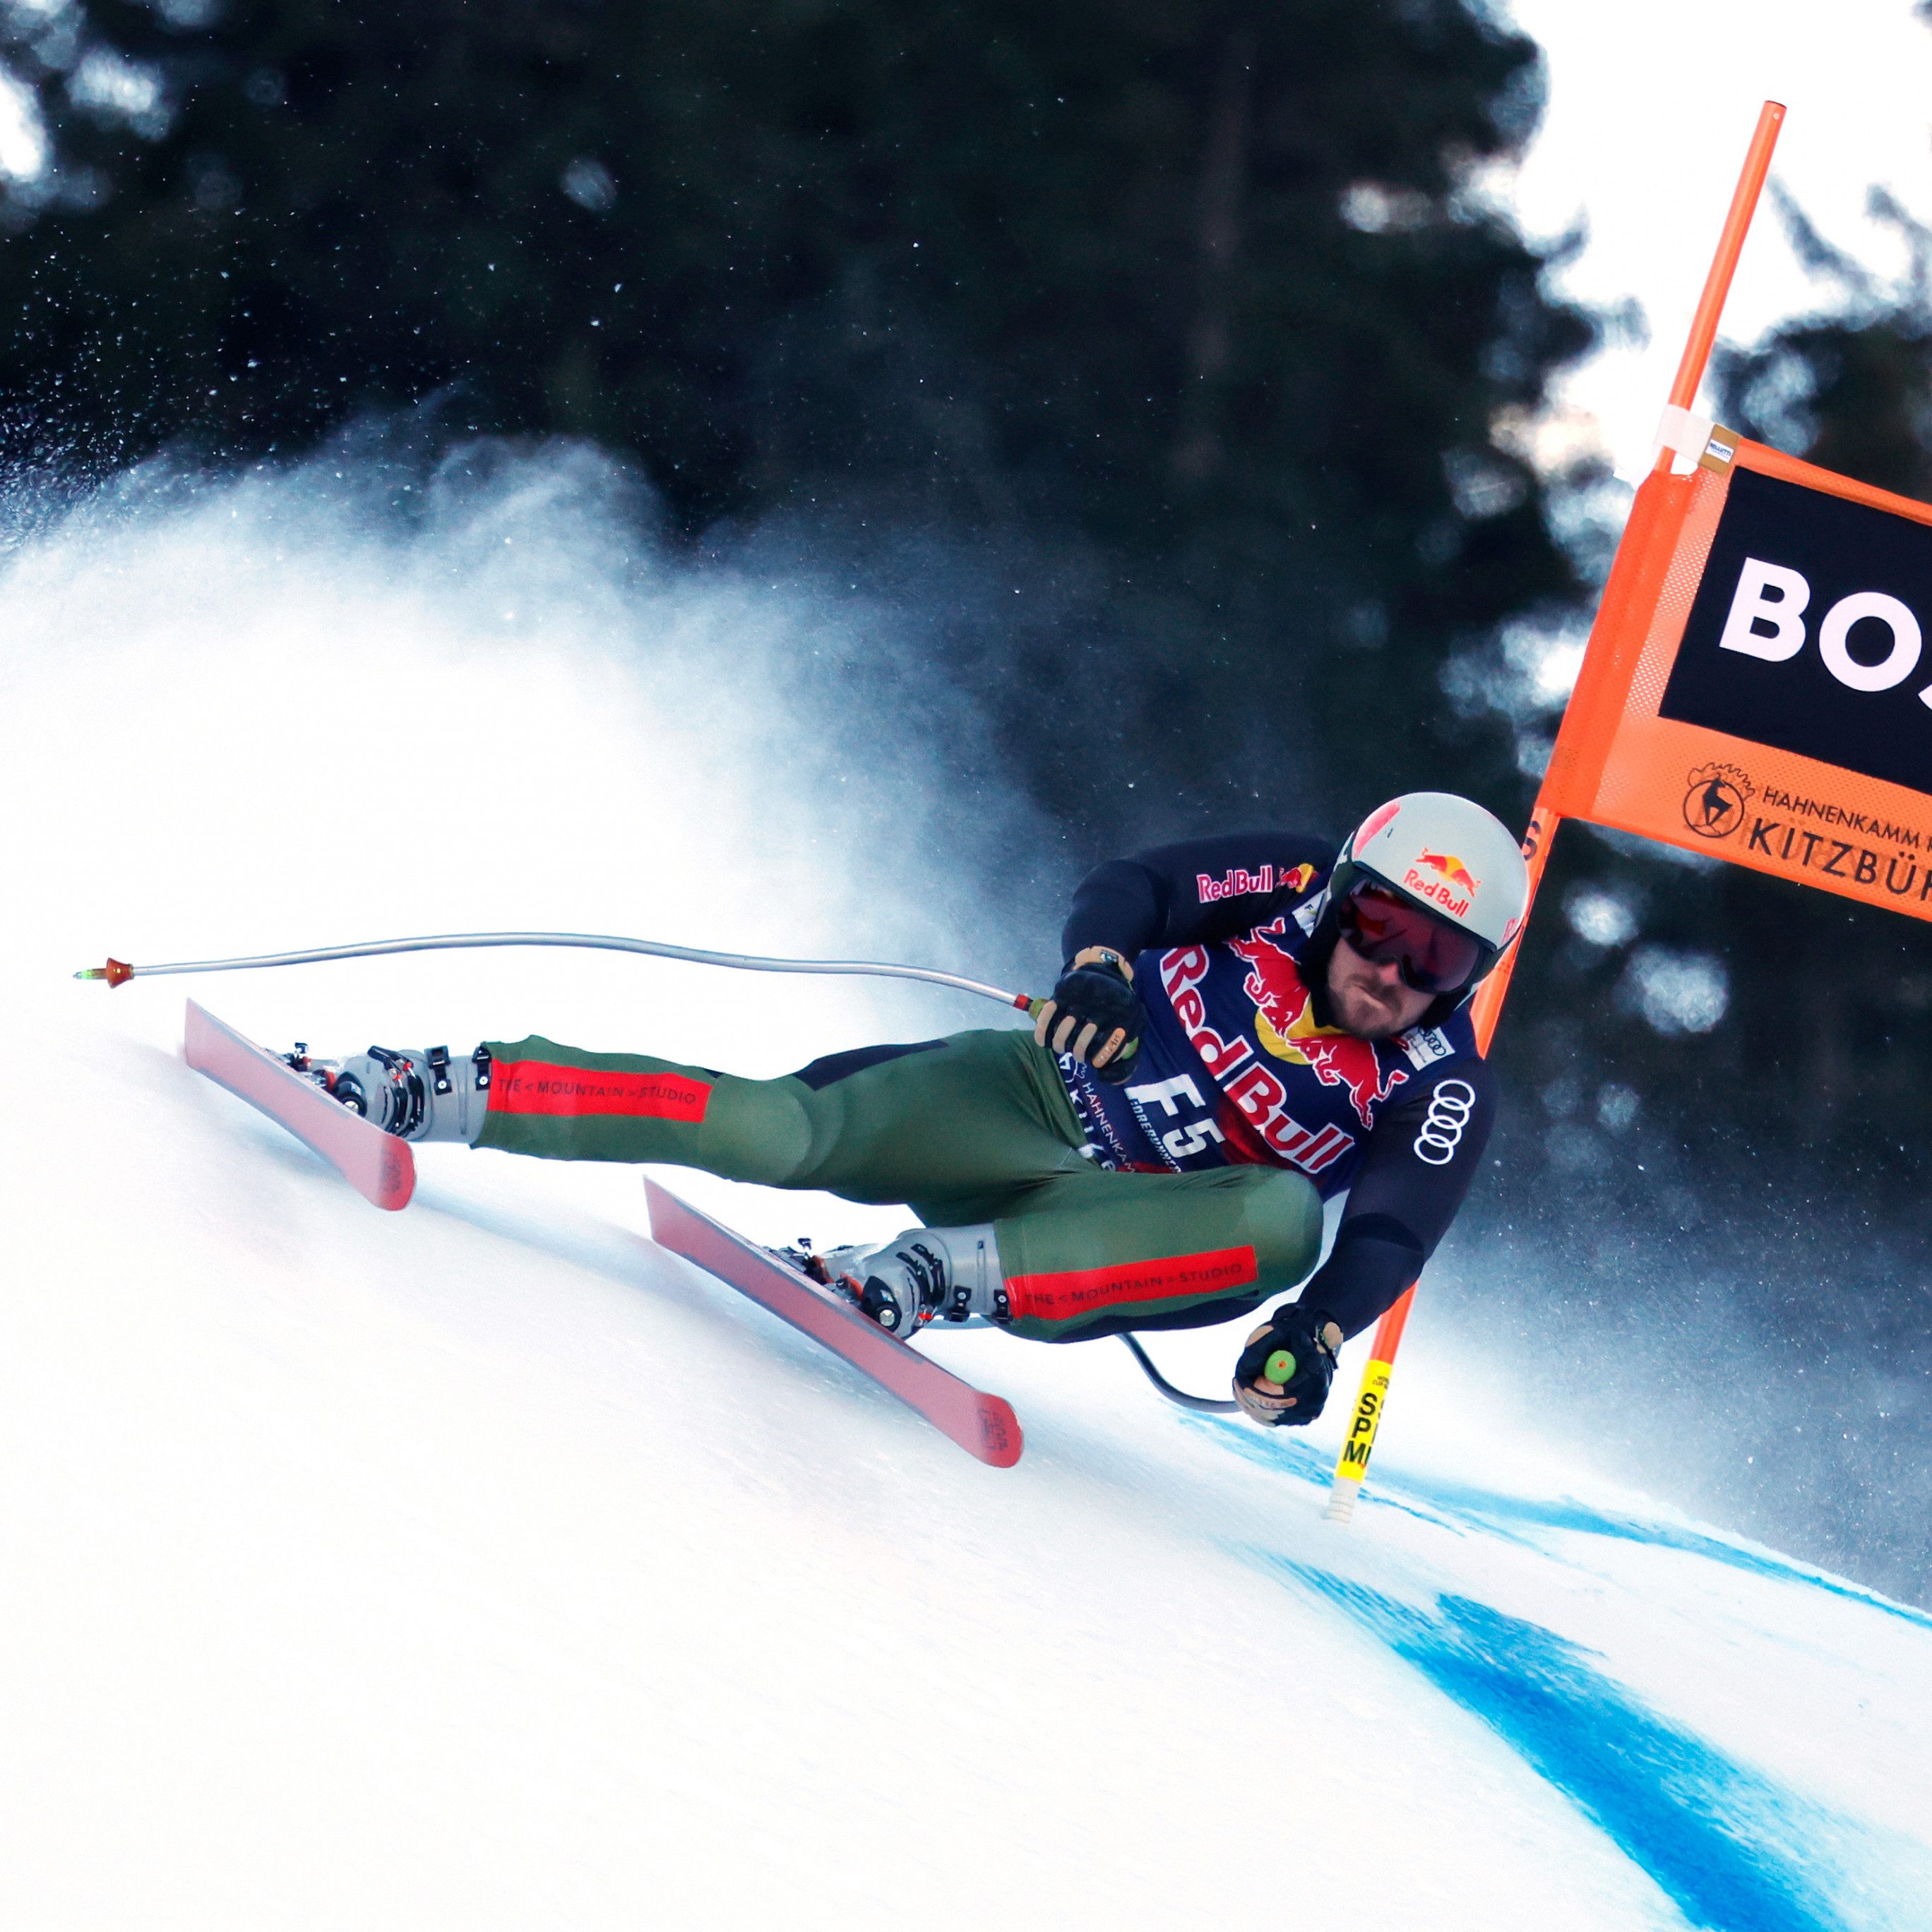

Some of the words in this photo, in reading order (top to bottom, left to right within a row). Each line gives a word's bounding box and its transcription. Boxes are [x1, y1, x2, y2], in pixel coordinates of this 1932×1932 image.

[1719, 556, 1932, 710] BO
[1763, 786, 1920, 849] HAHNENKAMM
[1196, 869, 1234, 903] Red
[1234, 865, 1272, 895] Bull
[1402, 868, 1440, 898] Red
[1435, 887, 1470, 917] Bull
[1159, 944, 1254, 1081] Red
[1223, 1061, 1355, 1174] Bull
[537, 1081, 624, 1097] MOUNTAIN
[638, 1086, 697, 1104] STUDIO
[1025, 1292, 1054, 1306] THE
[1071, 1277, 1163, 1302] MOUNTAIN
[1179, 1263, 1242, 1283] STUDIO
